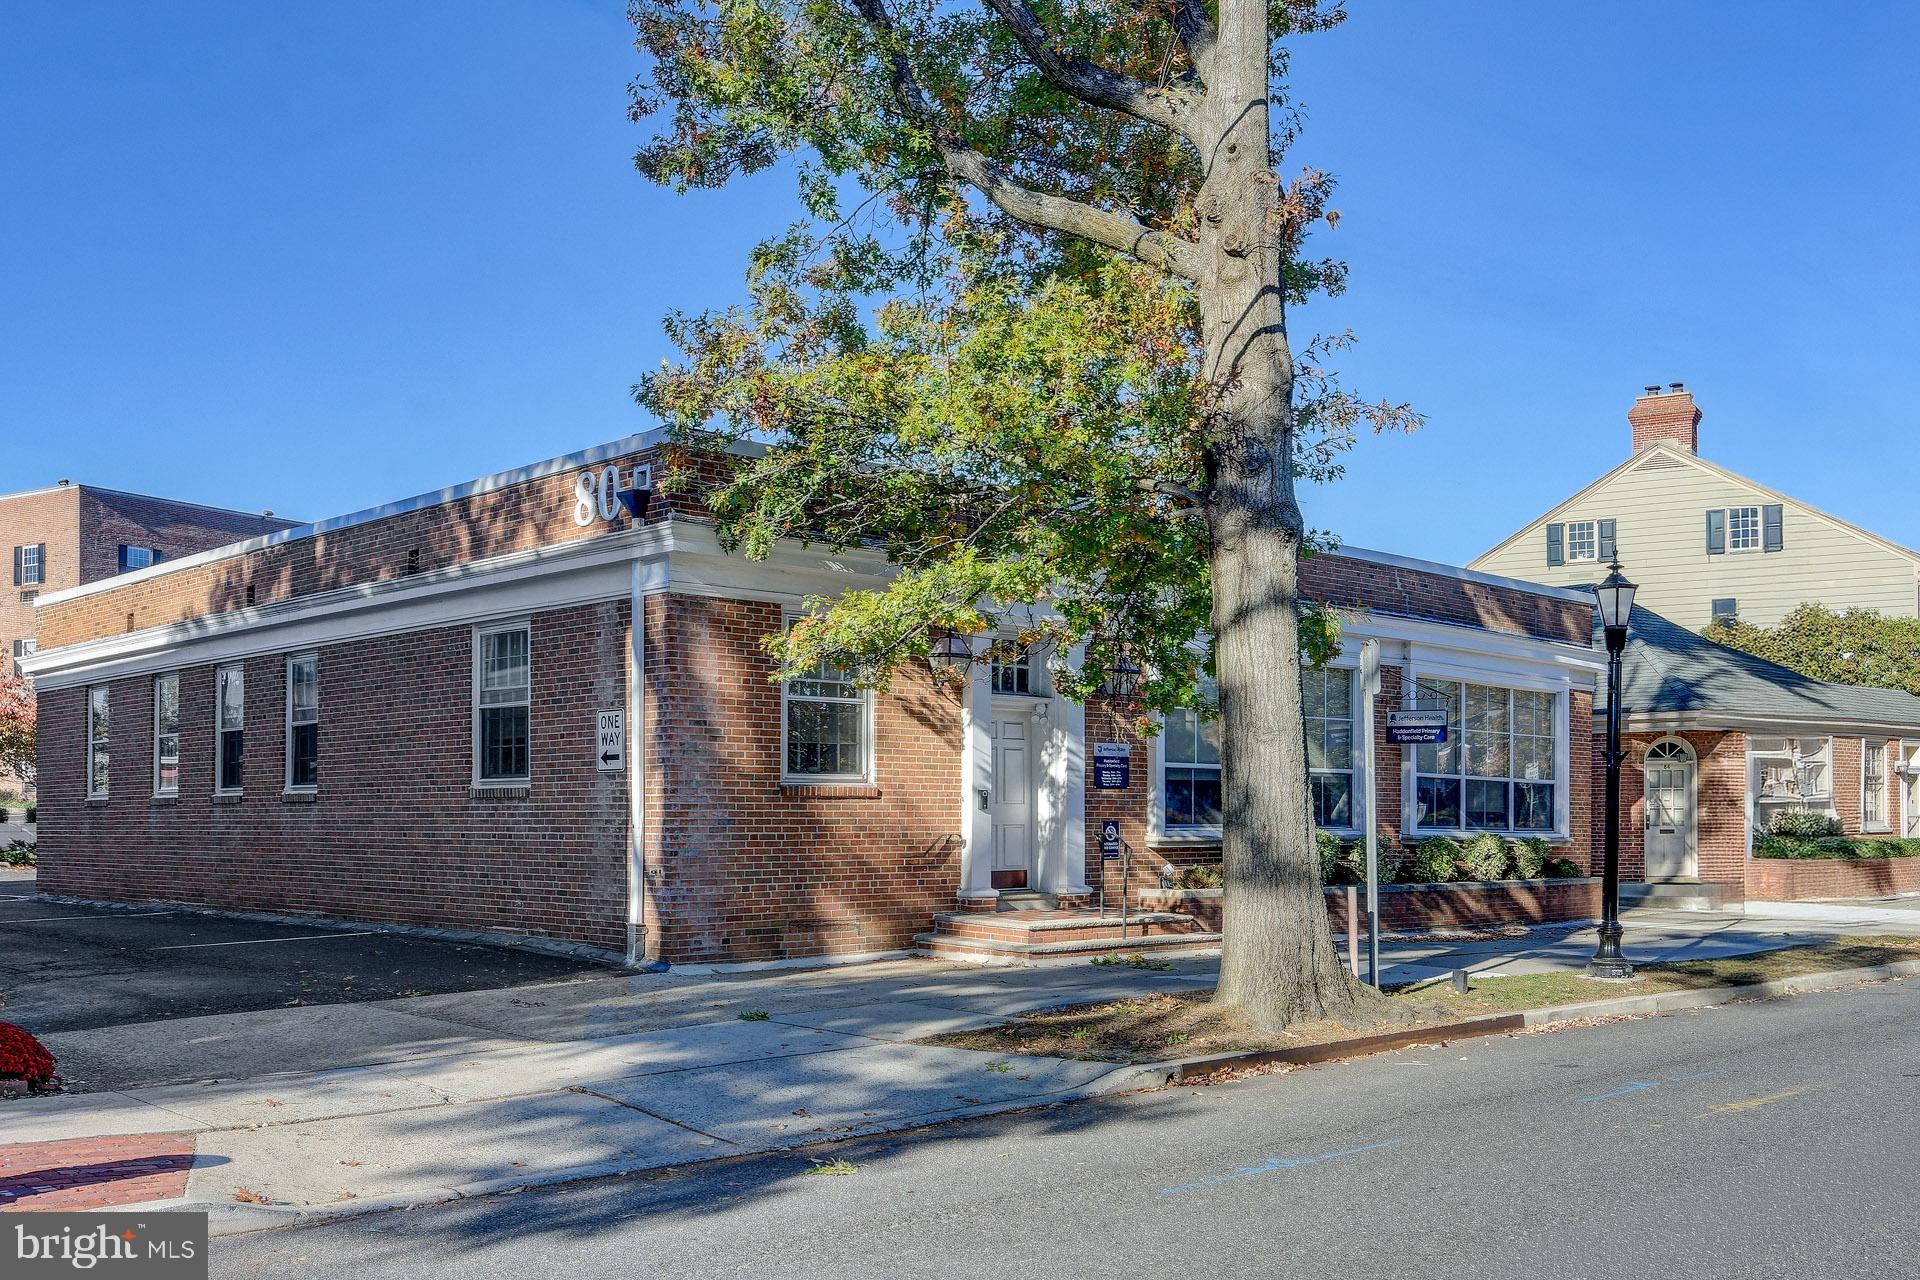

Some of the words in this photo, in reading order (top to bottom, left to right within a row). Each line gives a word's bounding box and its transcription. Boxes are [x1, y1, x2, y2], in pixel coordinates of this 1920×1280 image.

[574, 465, 621, 527] 80
[600, 714, 620, 730] ONE
[1398, 714, 1424, 722] Jefferson
[600, 731, 621, 747] WAY
